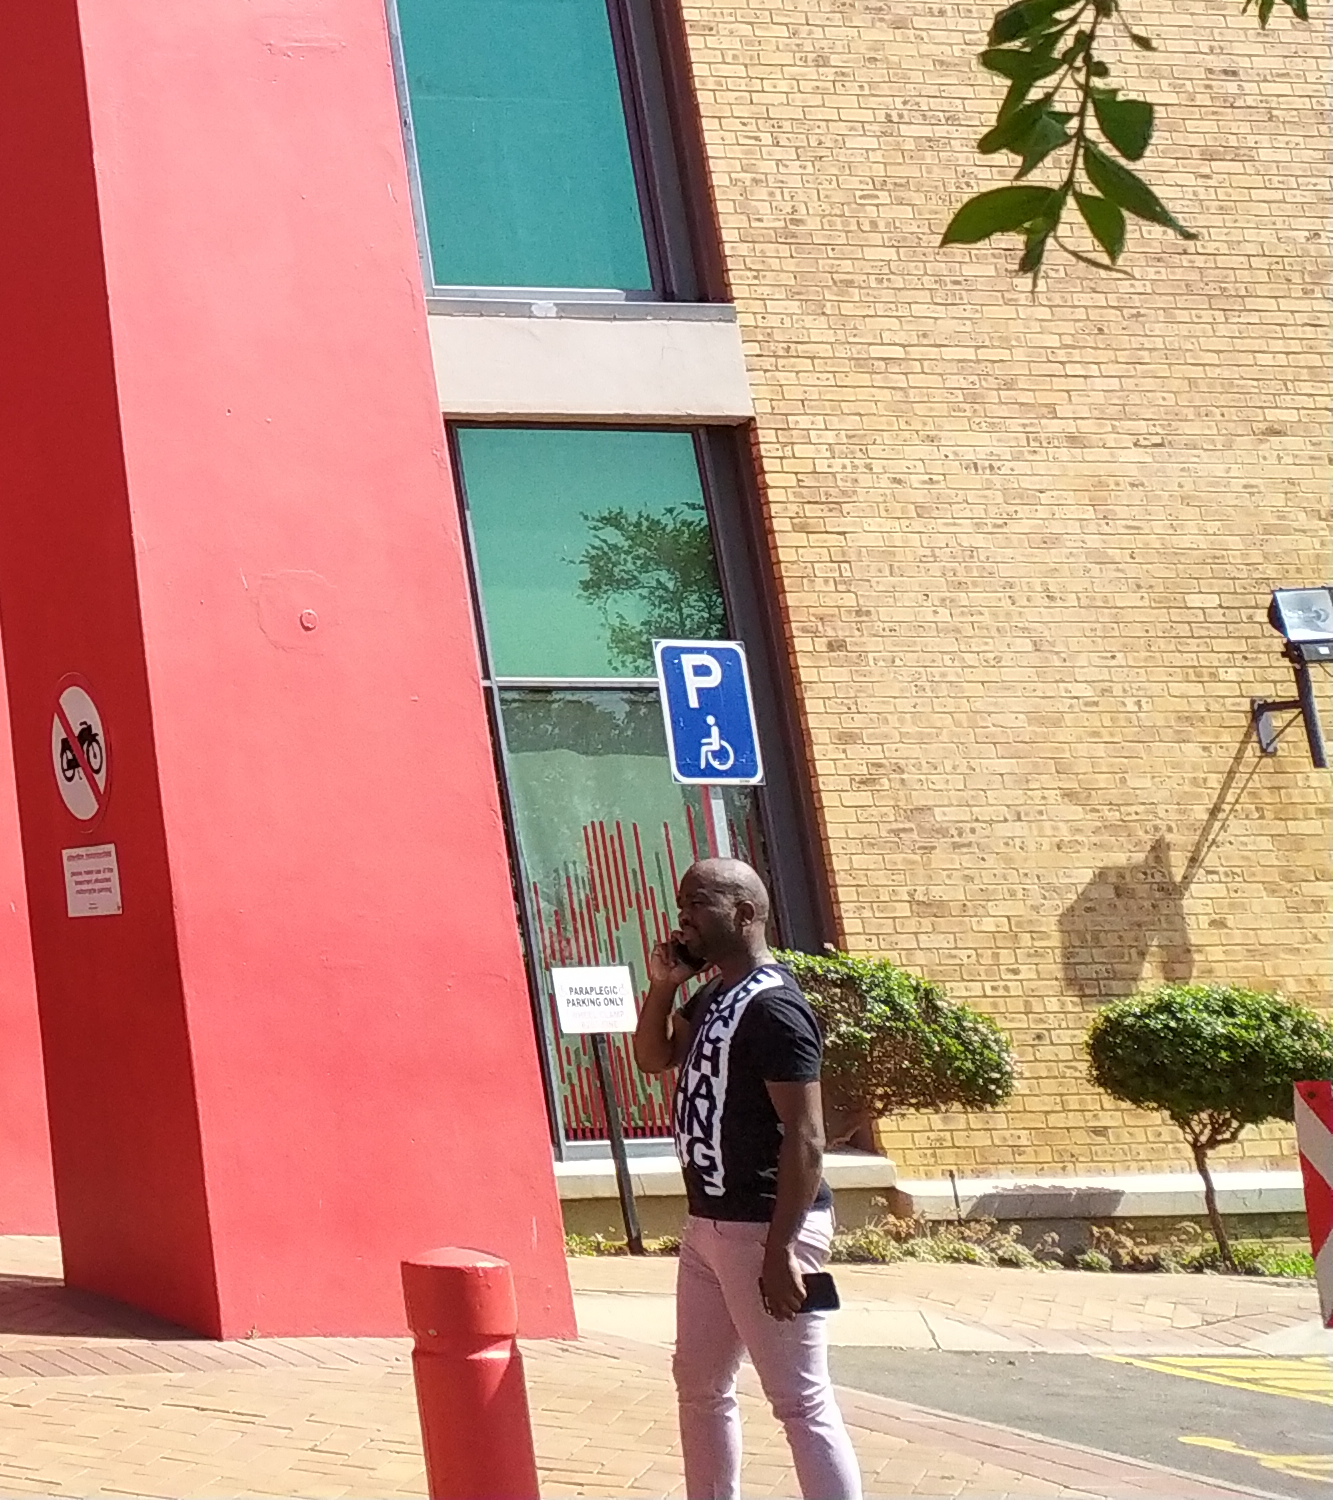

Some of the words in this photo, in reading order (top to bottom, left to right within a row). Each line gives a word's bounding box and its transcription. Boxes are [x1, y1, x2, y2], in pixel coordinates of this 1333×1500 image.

[680, 653, 723, 709] P
[568, 986, 618, 995] PARAPLEGIC
[566, 997, 602, 1007] PARKING
[603, 997, 624, 1006] ONLY
